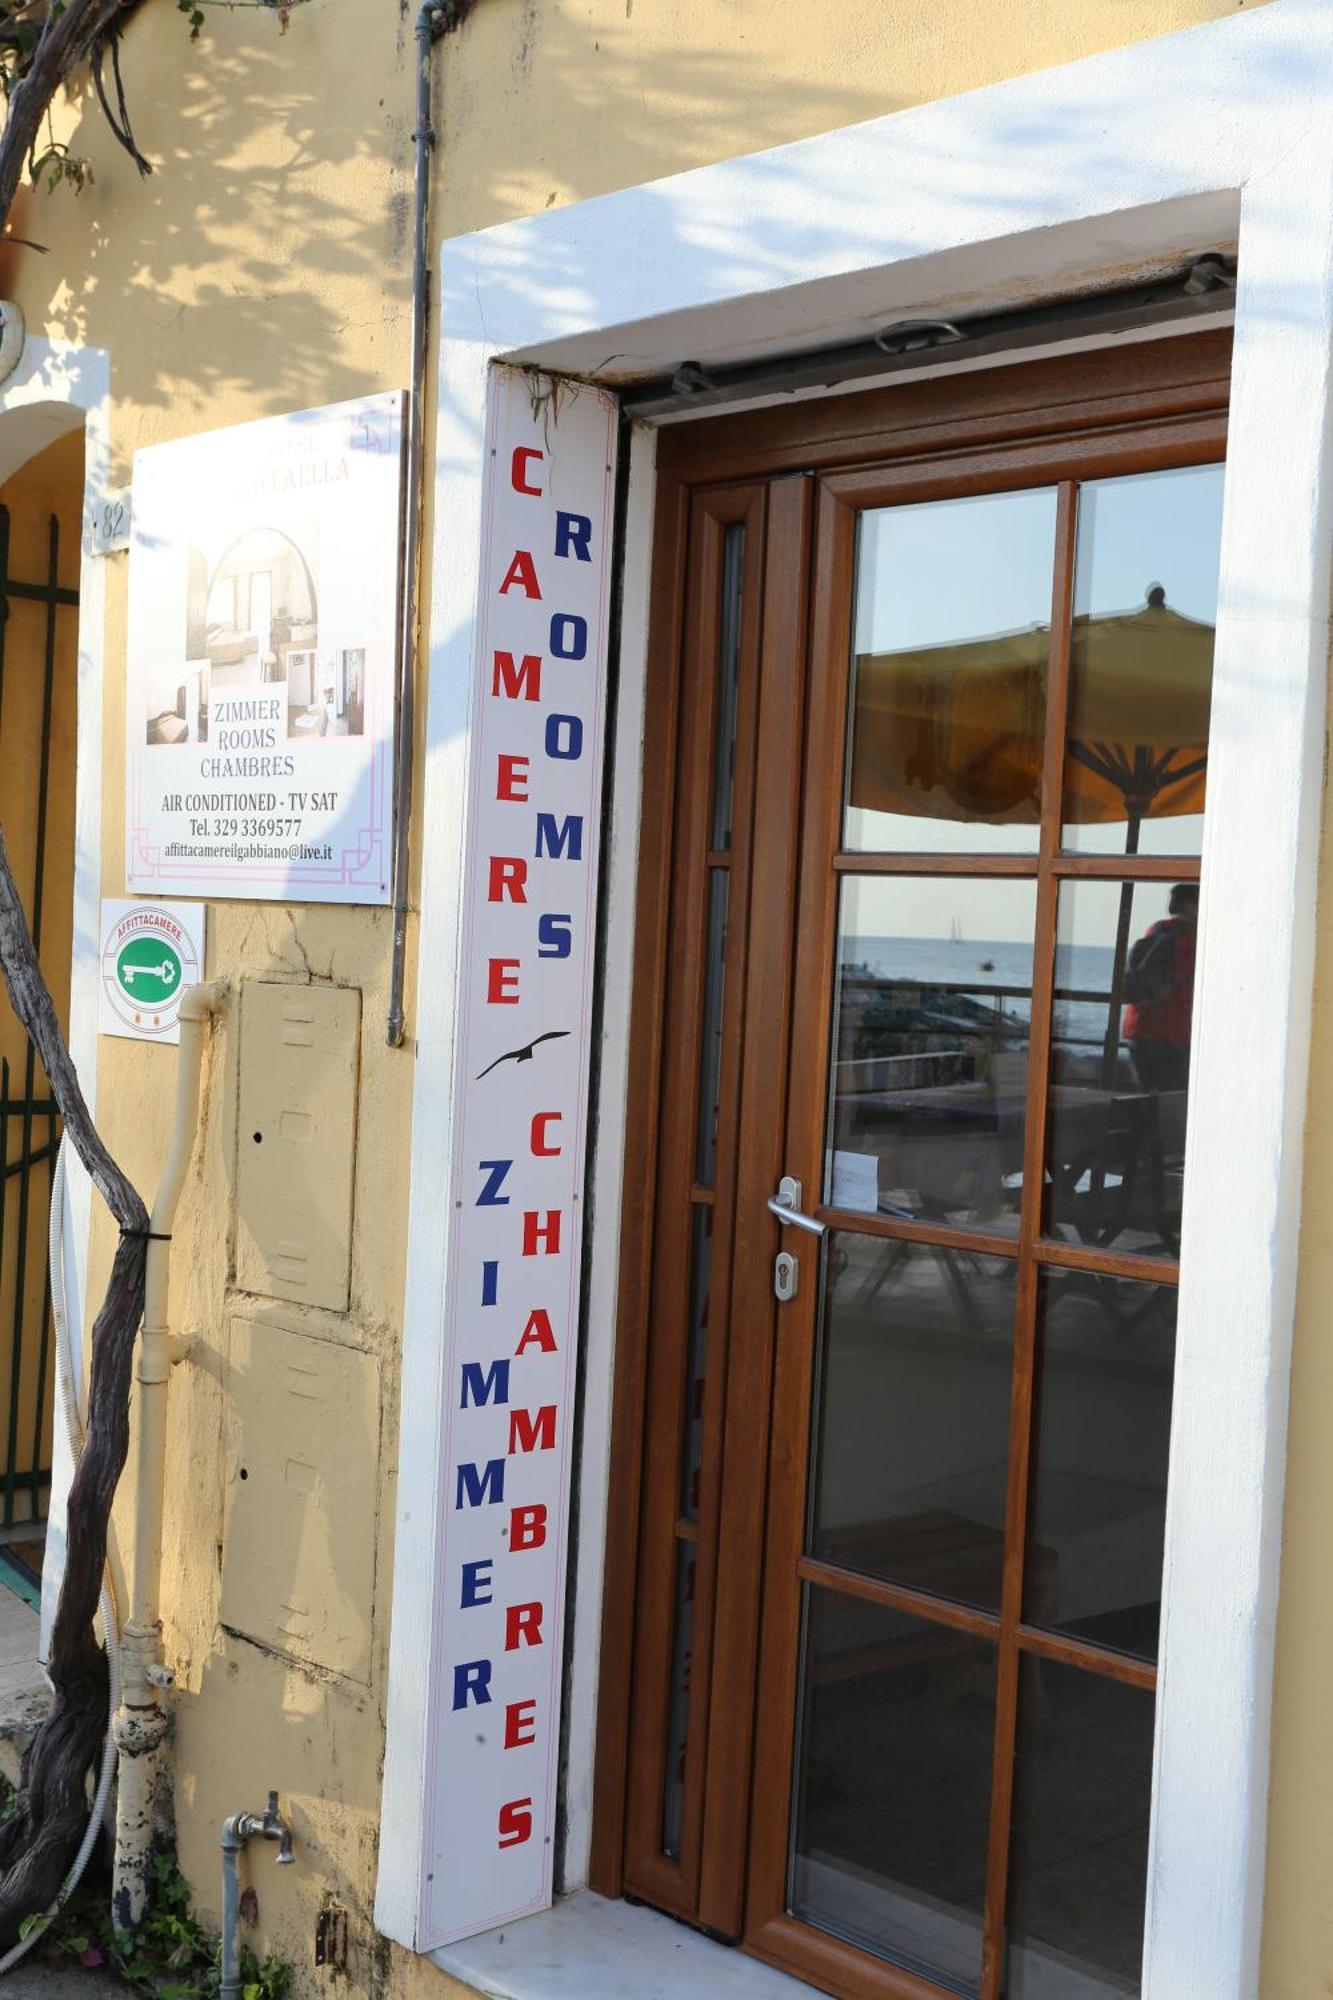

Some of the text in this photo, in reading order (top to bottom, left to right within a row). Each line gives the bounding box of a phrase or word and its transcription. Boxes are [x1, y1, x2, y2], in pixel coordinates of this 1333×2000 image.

[103, 502, 123, 537] 82
[214, 699, 281, 723] ZIMMER
[488, 448, 543, 1004] CAMERE
[535, 512, 591, 960] ROOMS
[219, 728, 276, 751] ROOMS
[200, 755, 295, 778] CHAMBRES
[161, 794, 182, 811] AIR
[185, 793, 276, 811] CONDITIONED
[288, 792, 308, 811] TV
[311, 792, 338, 811] SAT
[190, 818, 302, 837] Tel. 329 3369577
[164, 842, 333, 862] affittacamereilgabbiano@live.it
[117, 914, 182, 941] AFFITTACAMERE
[452, 1160, 512, 1712] ZIMMER
[499, 1112, 561, 1847] CHAMBRES
